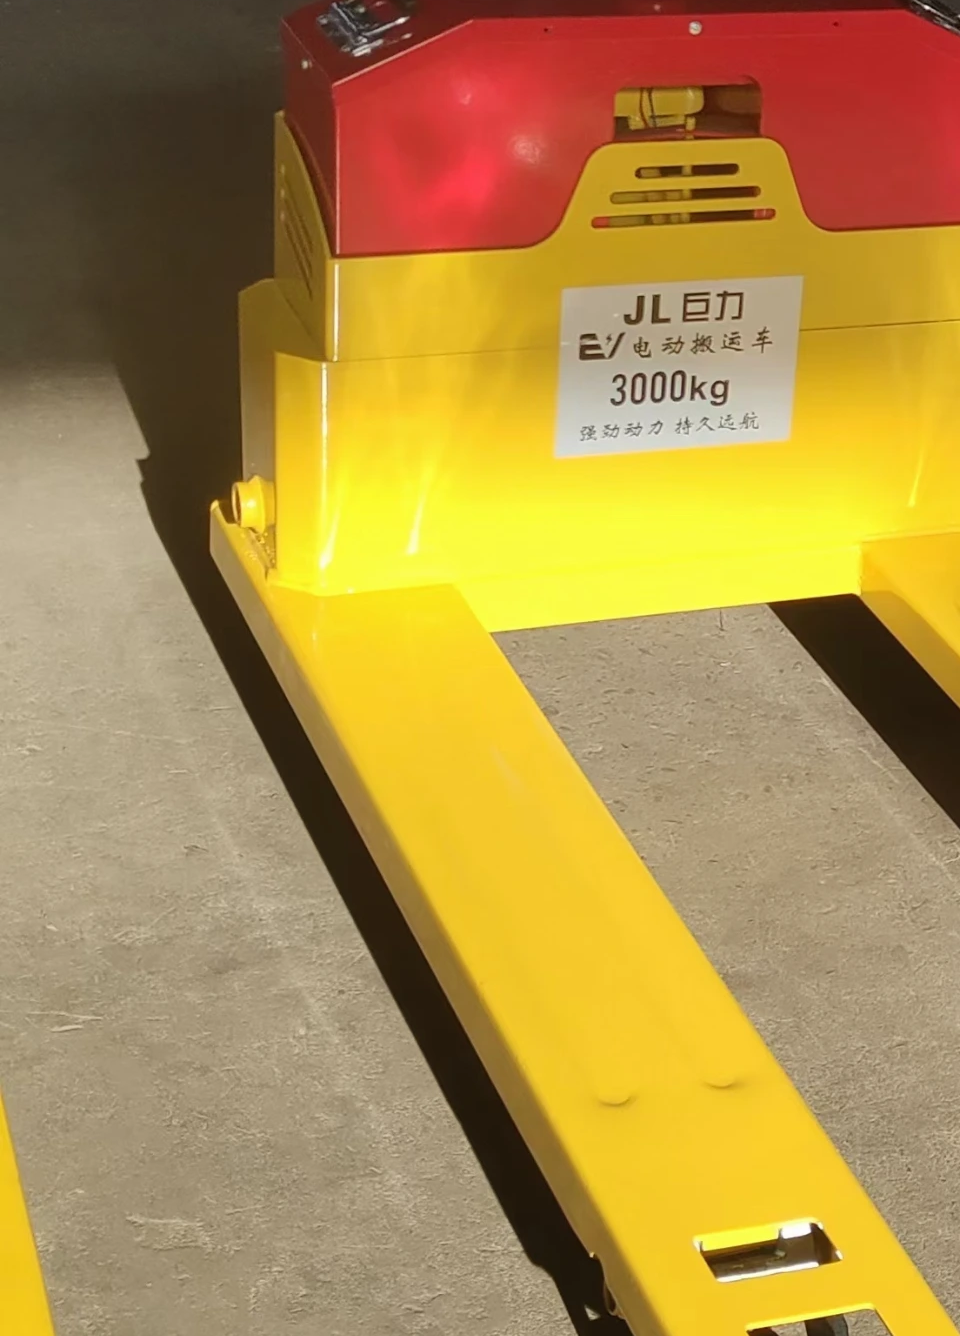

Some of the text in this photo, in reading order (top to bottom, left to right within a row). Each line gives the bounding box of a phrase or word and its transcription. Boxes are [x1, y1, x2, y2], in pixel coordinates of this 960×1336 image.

[623, 290, 744, 325] JL 巨力
[633, 326, 773, 358] 电动搬运车
[610, 369, 730, 406] 3000kg
[580, 411, 760, 442] 强劲动力 持久远航
